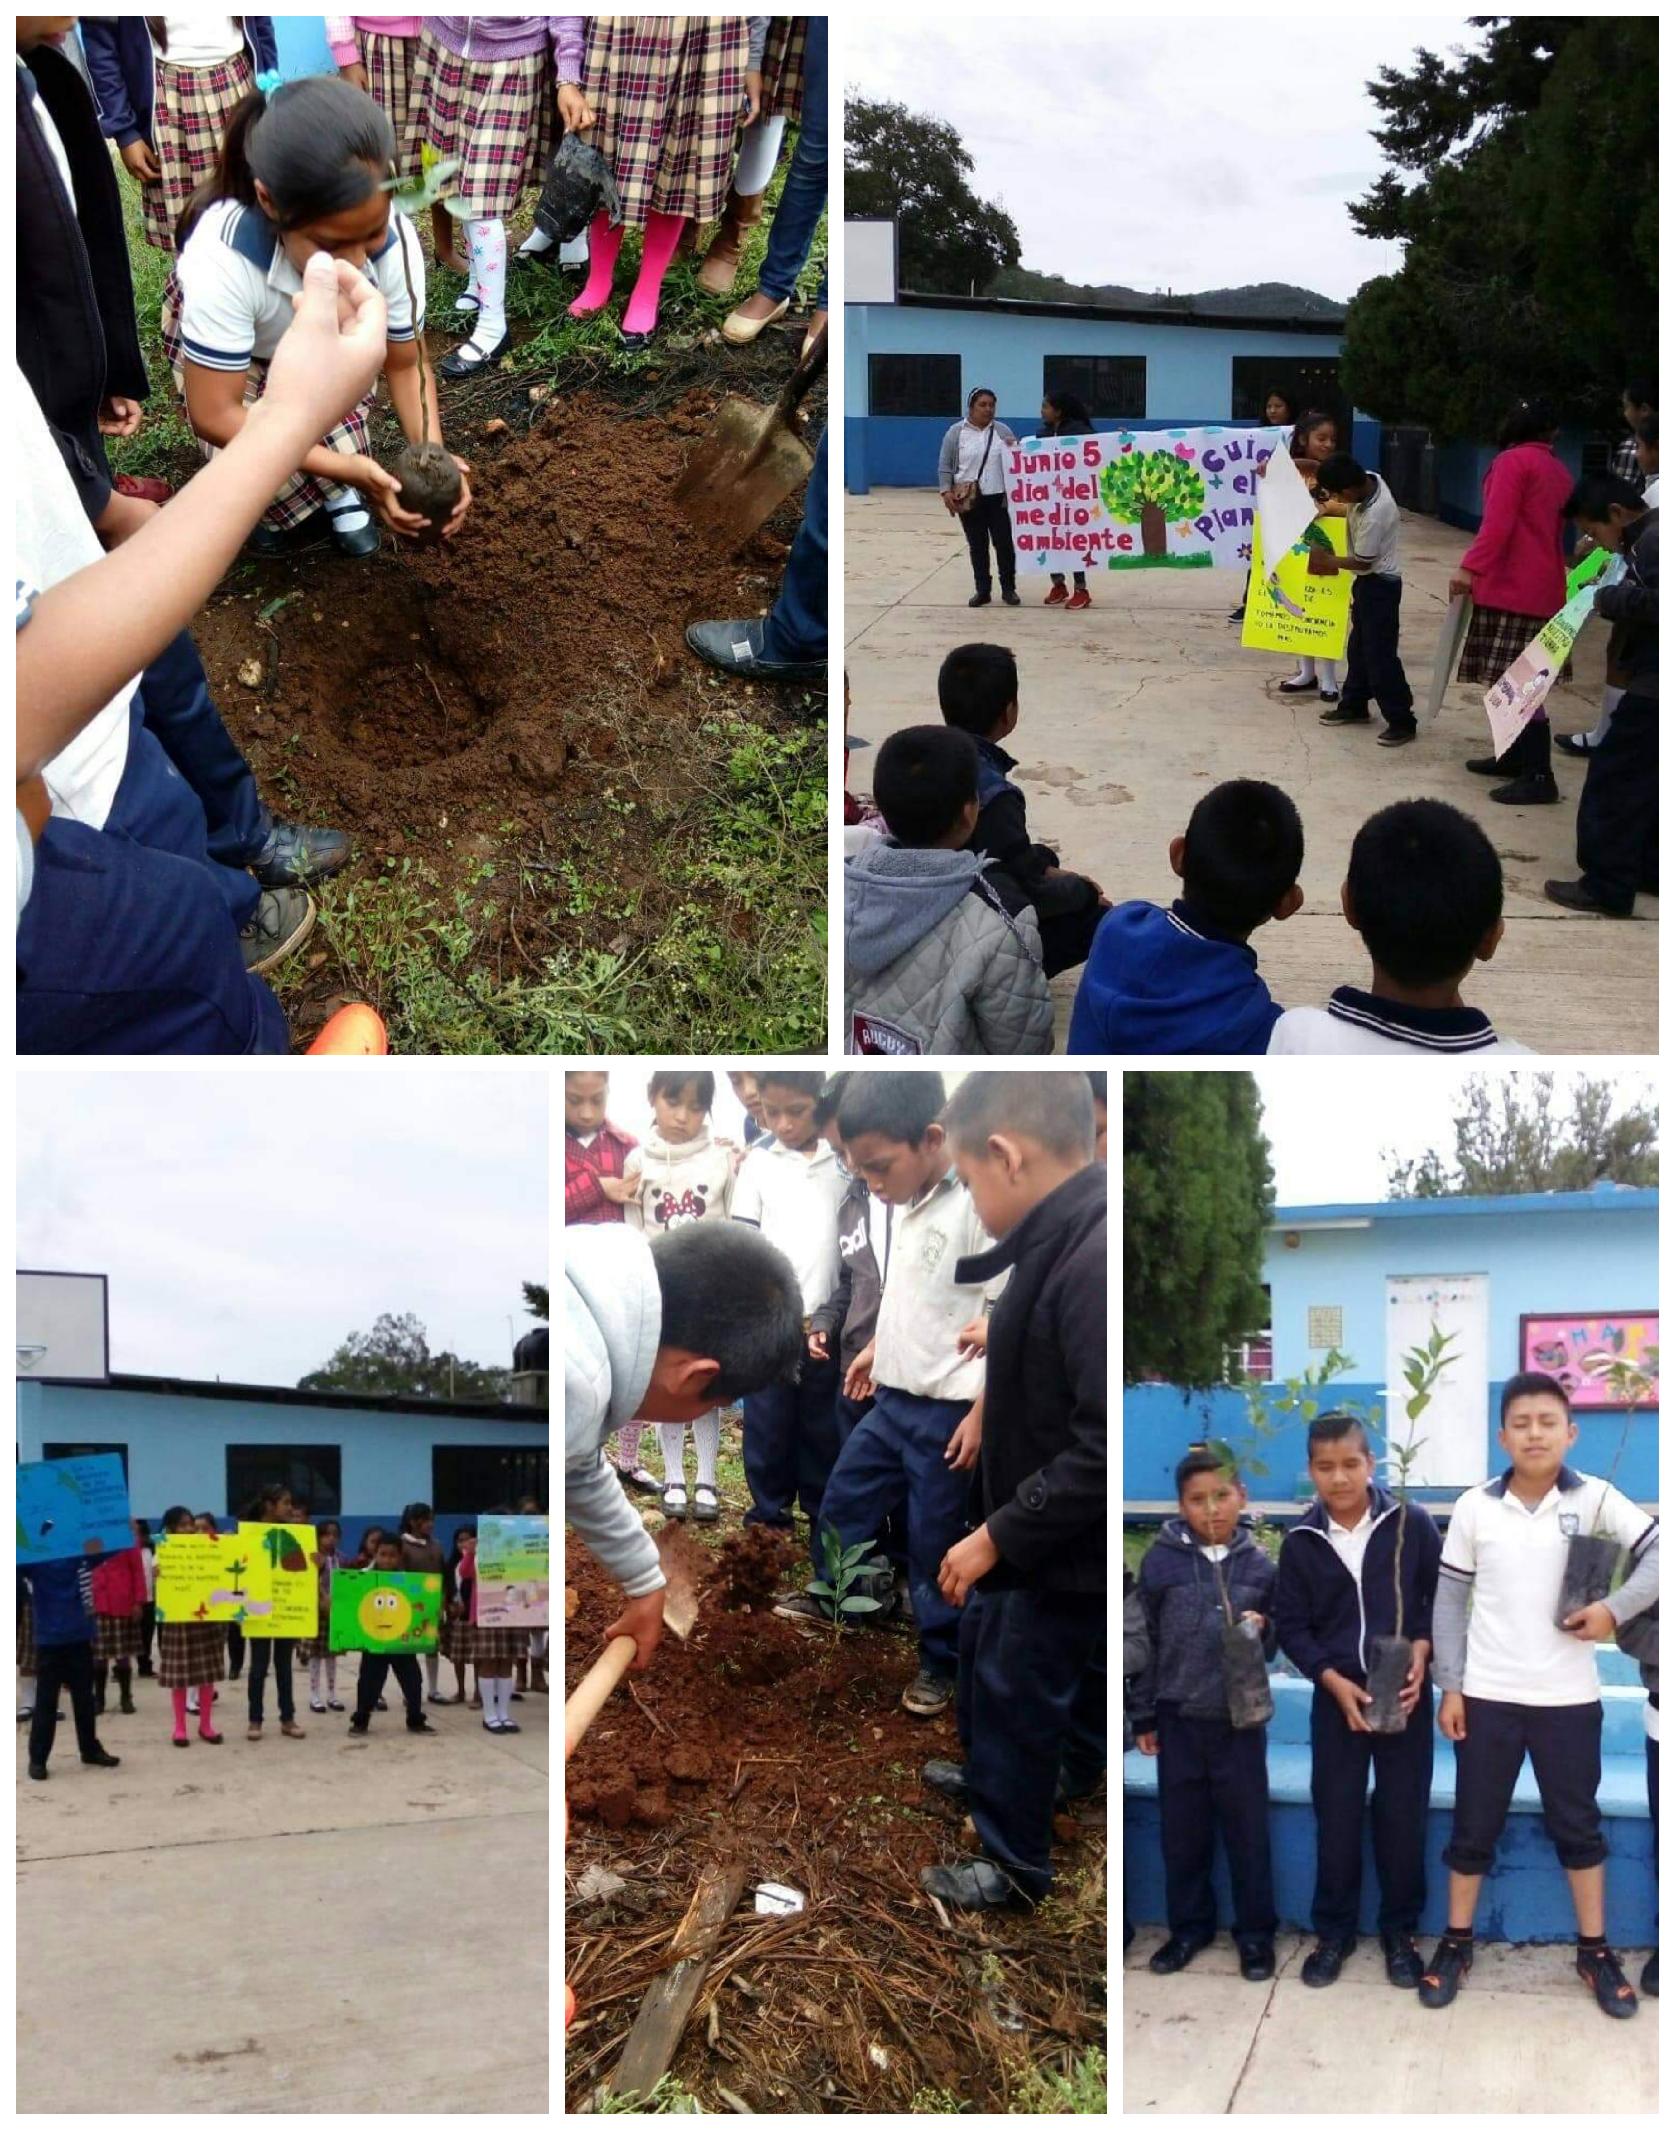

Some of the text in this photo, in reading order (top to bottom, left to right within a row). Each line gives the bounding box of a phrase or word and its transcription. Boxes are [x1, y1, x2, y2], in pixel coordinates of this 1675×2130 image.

[1009, 440, 1101, 475] Junio 5
[1011, 473, 1098, 503] dia del
[1233, 469, 1257, 496] el
[1016, 502, 1089, 526] medio
[1017, 526, 1133, 552] ambiente
